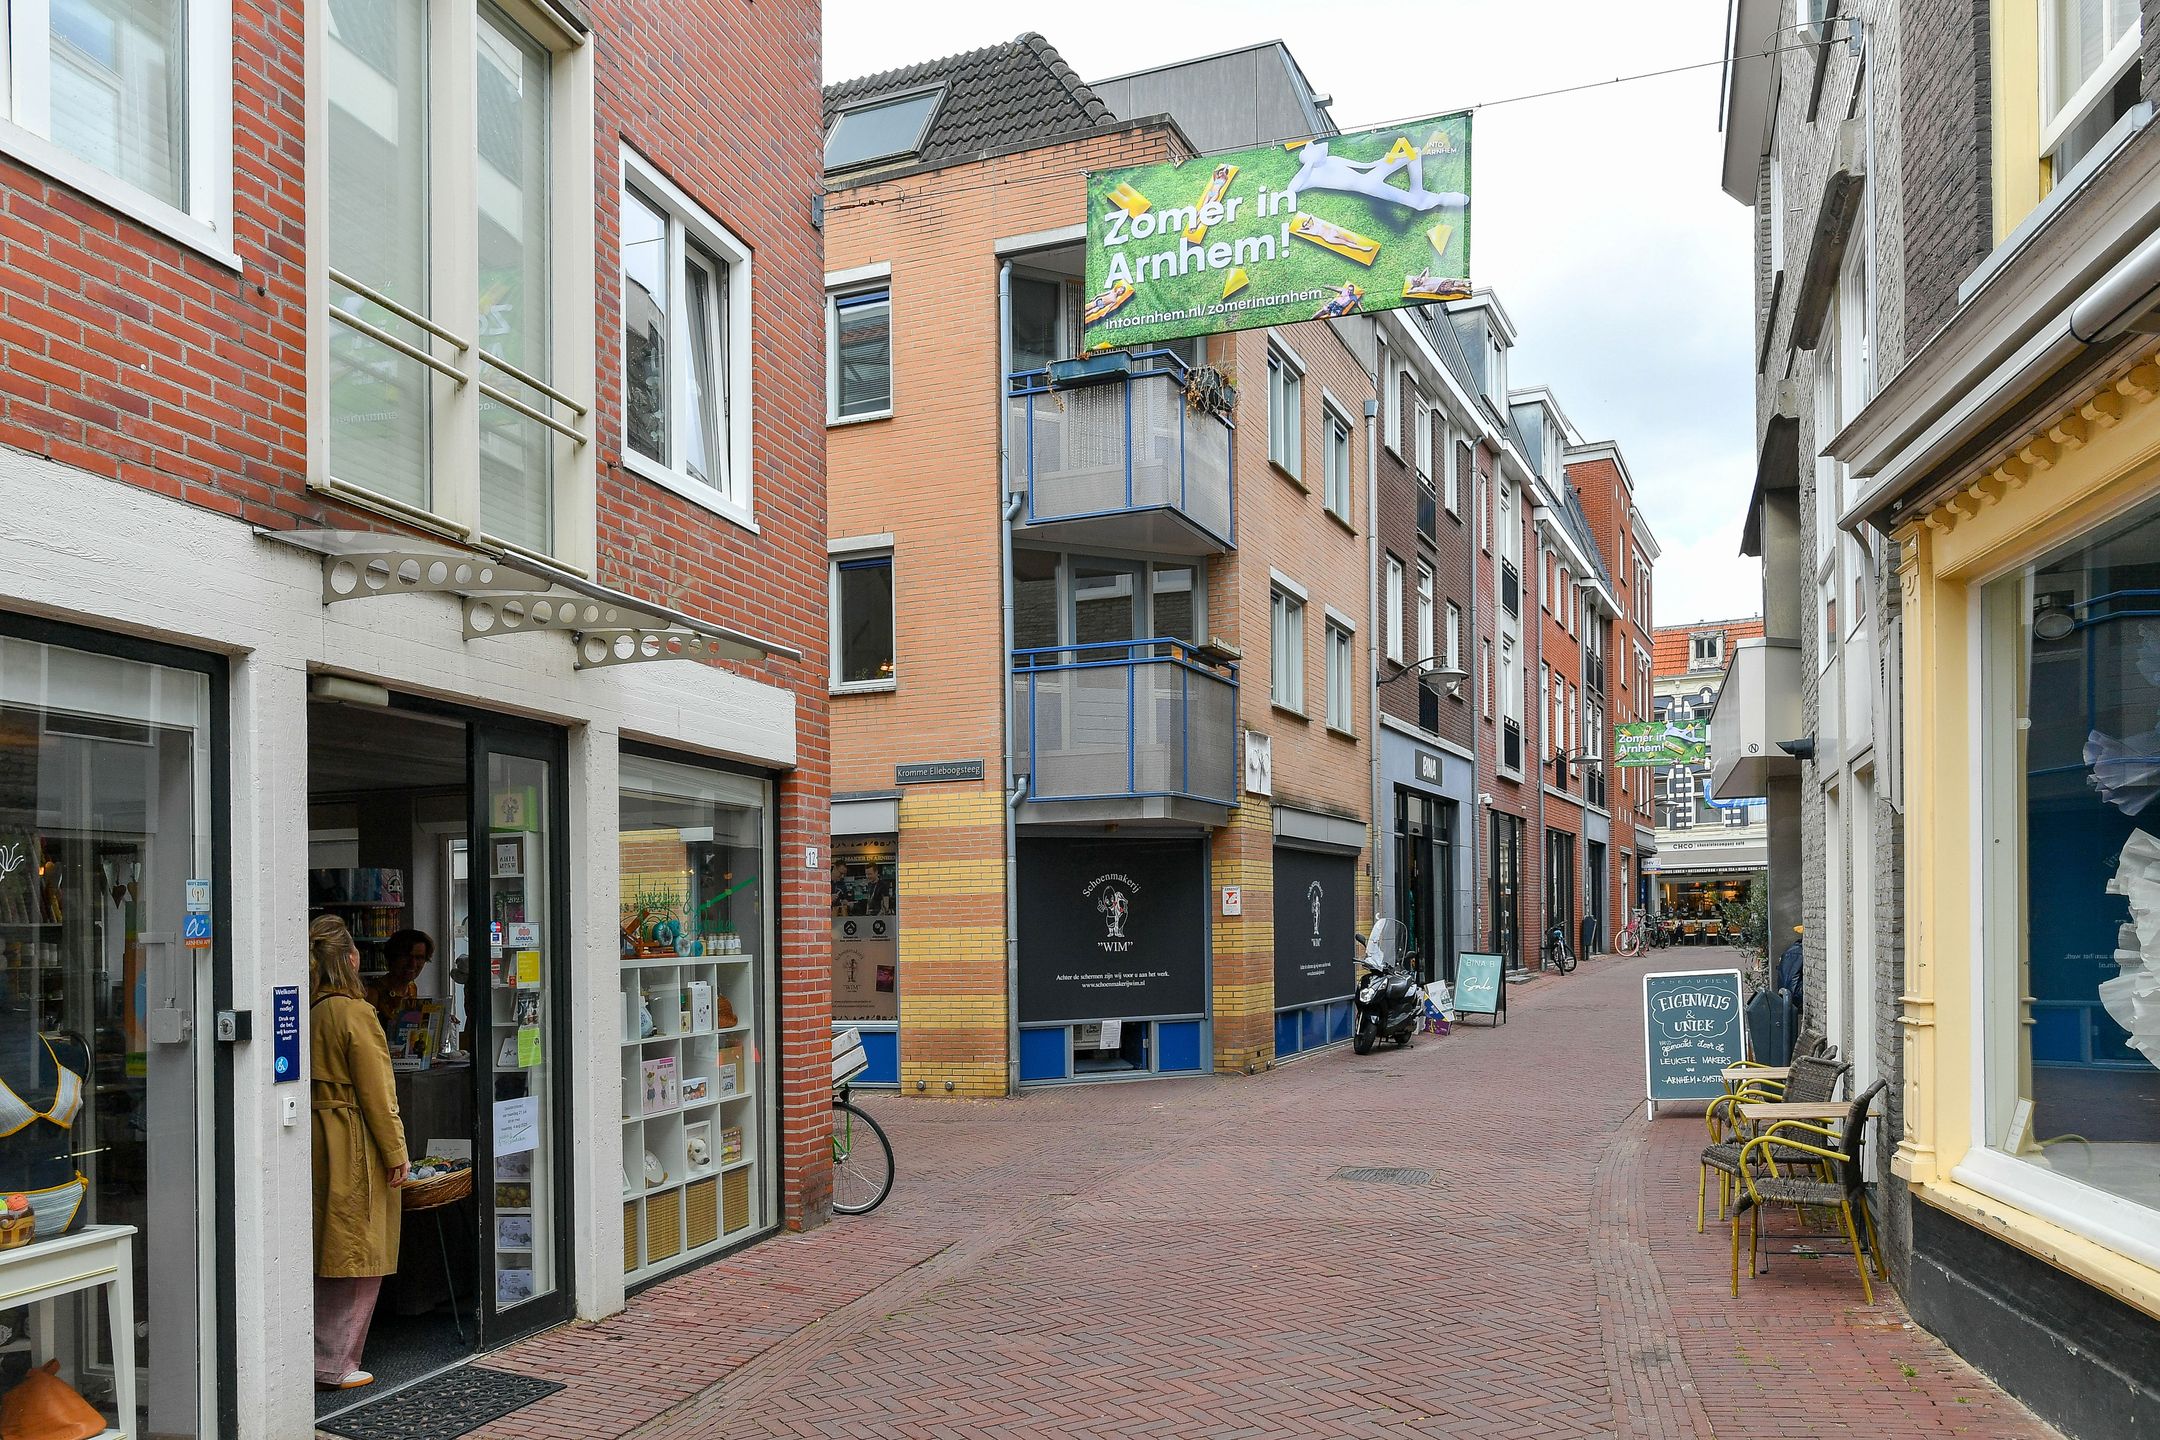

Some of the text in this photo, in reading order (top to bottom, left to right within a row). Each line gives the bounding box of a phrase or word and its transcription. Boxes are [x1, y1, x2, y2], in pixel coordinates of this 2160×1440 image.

[1104, 186, 1298, 248] Zomer in
[1104, 223, 1291, 290] Arnhem!
[1105, 288, 1323, 331] intoarnhem.nl/zomerinarnhem
[1619, 732, 1666, 743] Zomer in
[1619, 744, 1665, 753] Arnhem!
[897, 765, 980, 777] Kromme Elleboogsteeg
[808, 851, 816, 866] 12
[1082, 873, 1141, 897] Schoenmakerij
[1658, 993, 1731, 1012] EIGENWIJS
[1685, 1010, 1695, 1020] &
[1674, 1020, 1715, 1032] UNIEK
[1662, 1039, 1725, 1057] gemaakt door de
[1660, 1056, 1732, 1066] LEUKSTE MAKERS
[1666, 1075, 1697, 1084] ARNHEM
